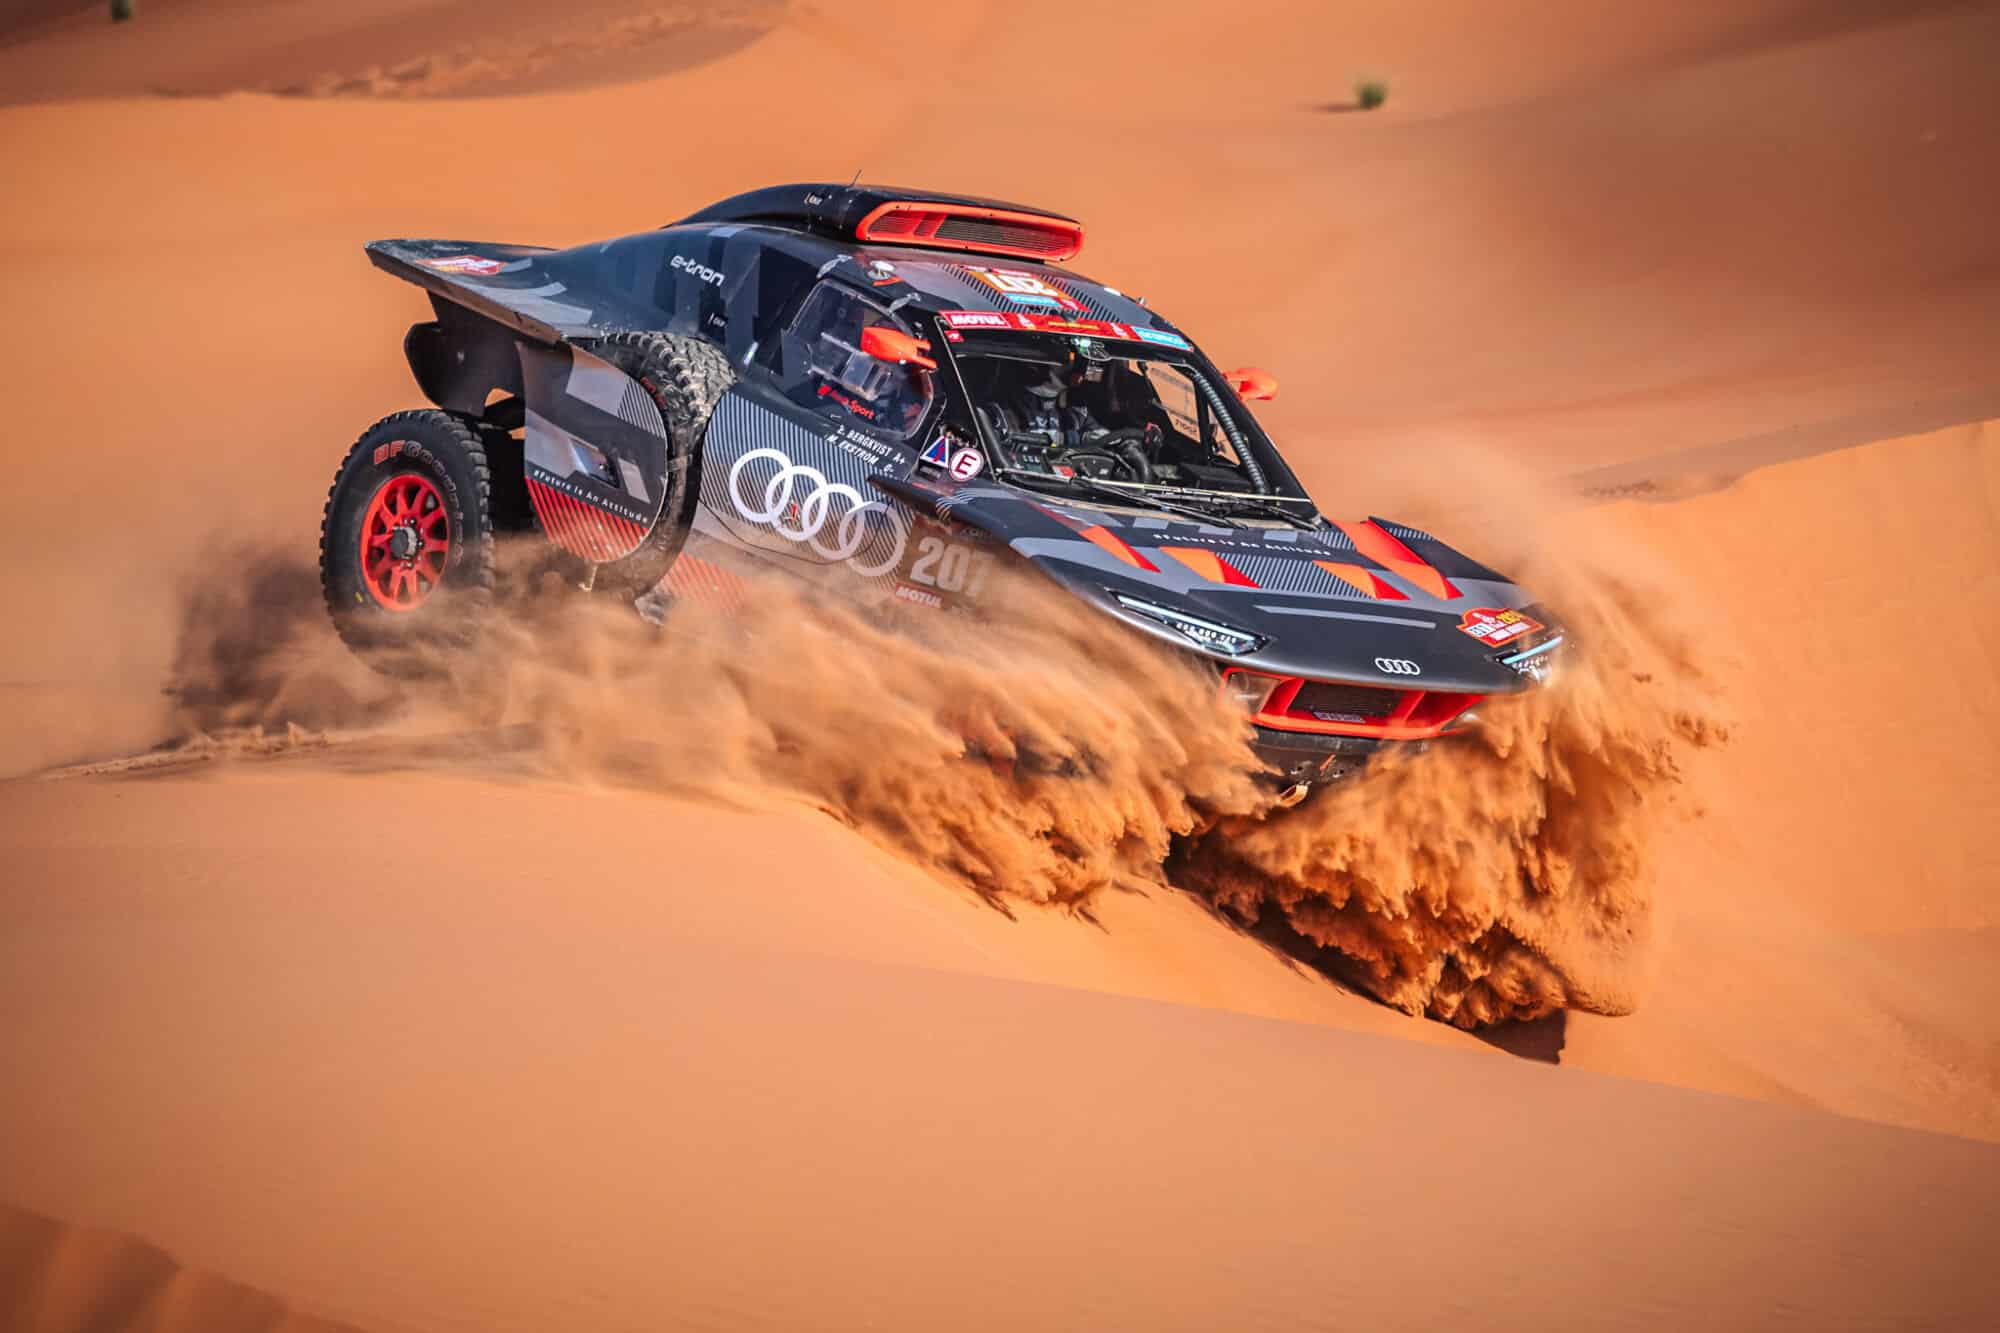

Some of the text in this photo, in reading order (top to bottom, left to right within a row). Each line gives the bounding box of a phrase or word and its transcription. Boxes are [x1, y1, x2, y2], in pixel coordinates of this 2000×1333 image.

[670, 255, 725, 287] e-tron
[950, 314, 1006, 326] MOTUL
[954, 453, 977, 476] E
[910, 536, 996, 598] 207
[896, 585, 943, 609] MOTUL
